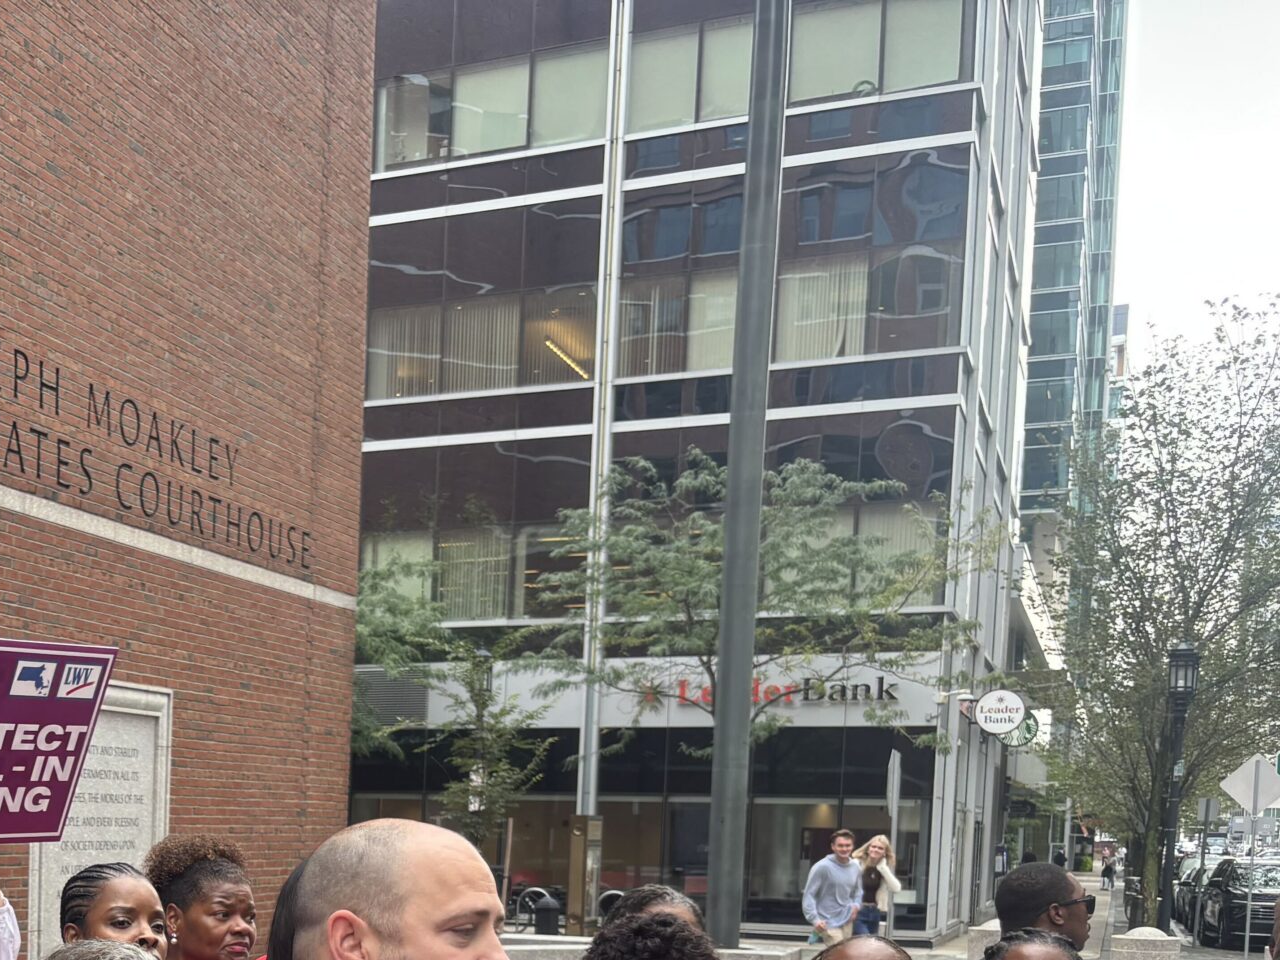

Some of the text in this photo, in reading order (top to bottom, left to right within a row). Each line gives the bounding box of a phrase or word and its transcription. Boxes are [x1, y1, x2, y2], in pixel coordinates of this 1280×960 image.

[86, 383, 240, 488] MOAKLEY
[115, 462, 313, 570] COURTHOUSE
[64, 666, 94, 686] LWV
[980, 705, 1021, 714] Leader
[984, 716, 1015, 724] Bank
[101, 793, 123, 804] MORALS
[124, 794, 133, 804] OF
[134, 794, 144, 805] THE
[82, 817, 95, 827] AND
[61, 840, 70, 851] OF
